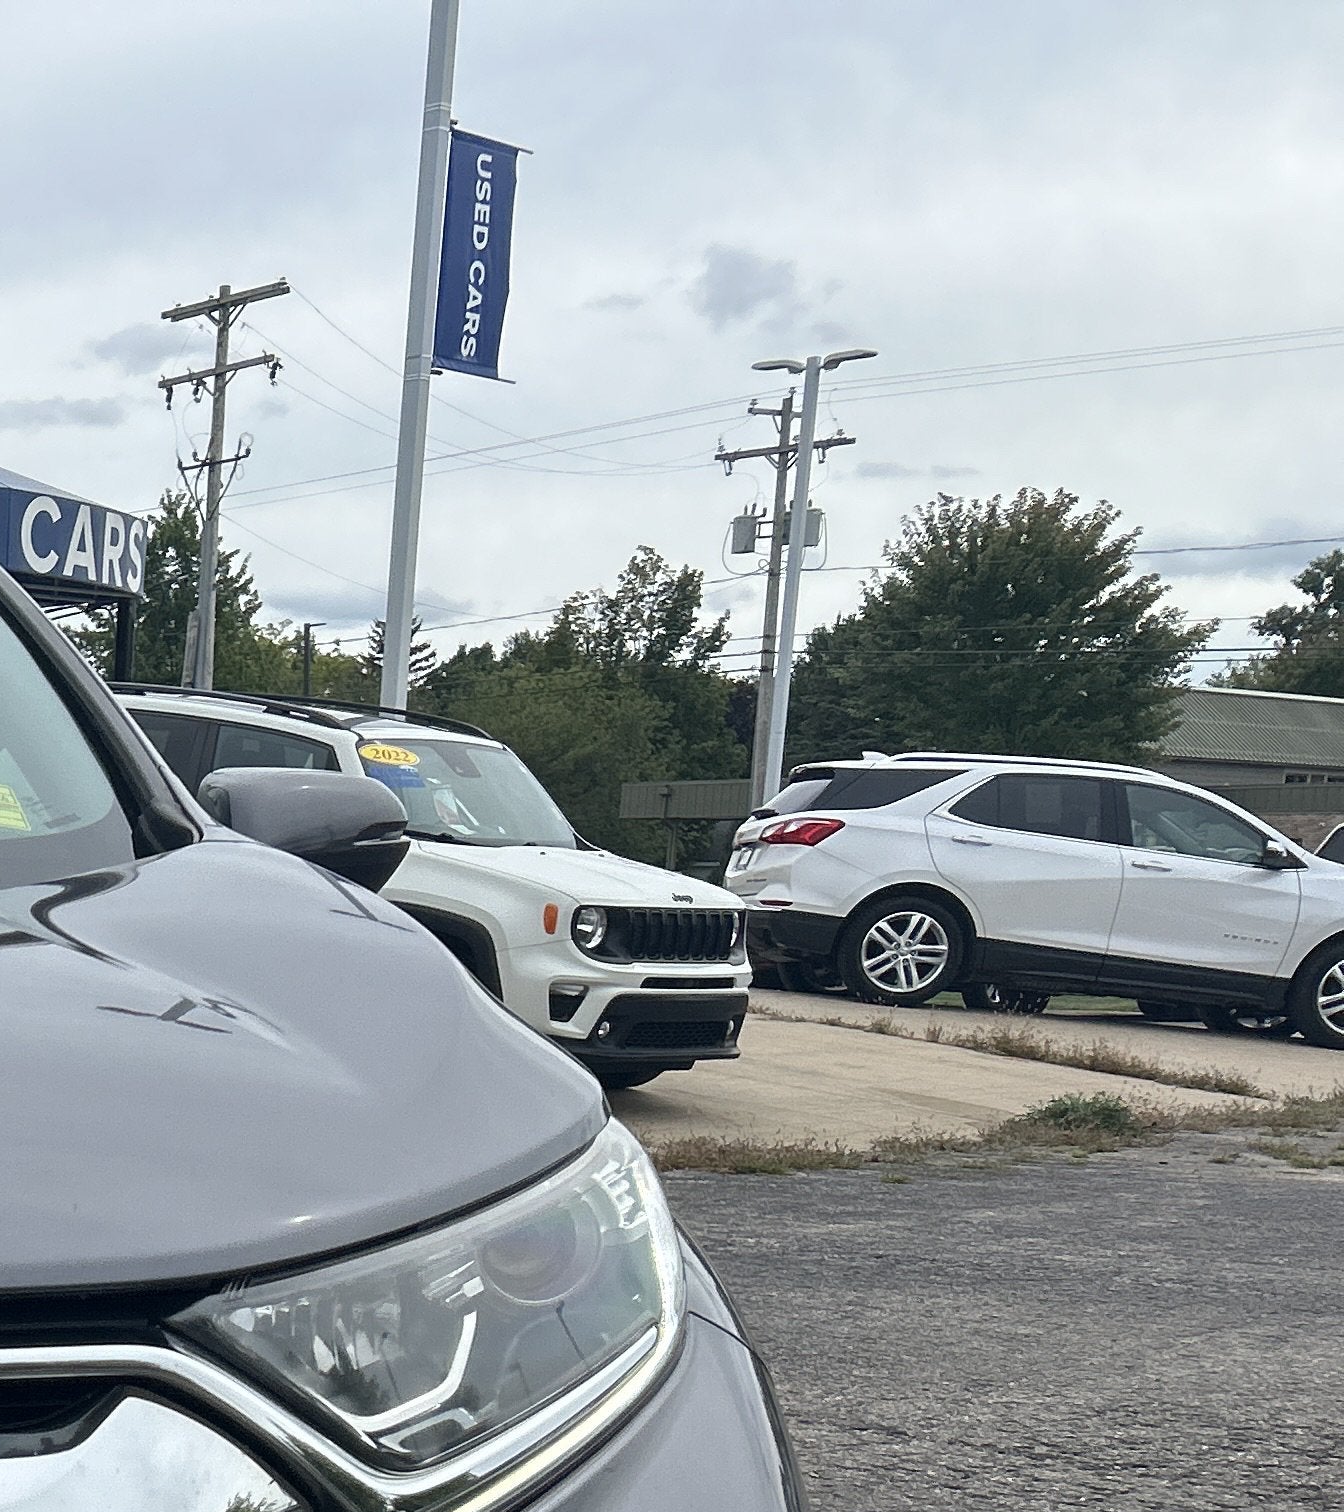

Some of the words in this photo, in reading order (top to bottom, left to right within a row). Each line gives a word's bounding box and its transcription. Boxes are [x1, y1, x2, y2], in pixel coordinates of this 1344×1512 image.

[472, 152, 493, 251] USED
[460, 260, 486, 358] CARS
[20, 495, 146, 593] CARS
[370, 748, 412, 763] 2022
